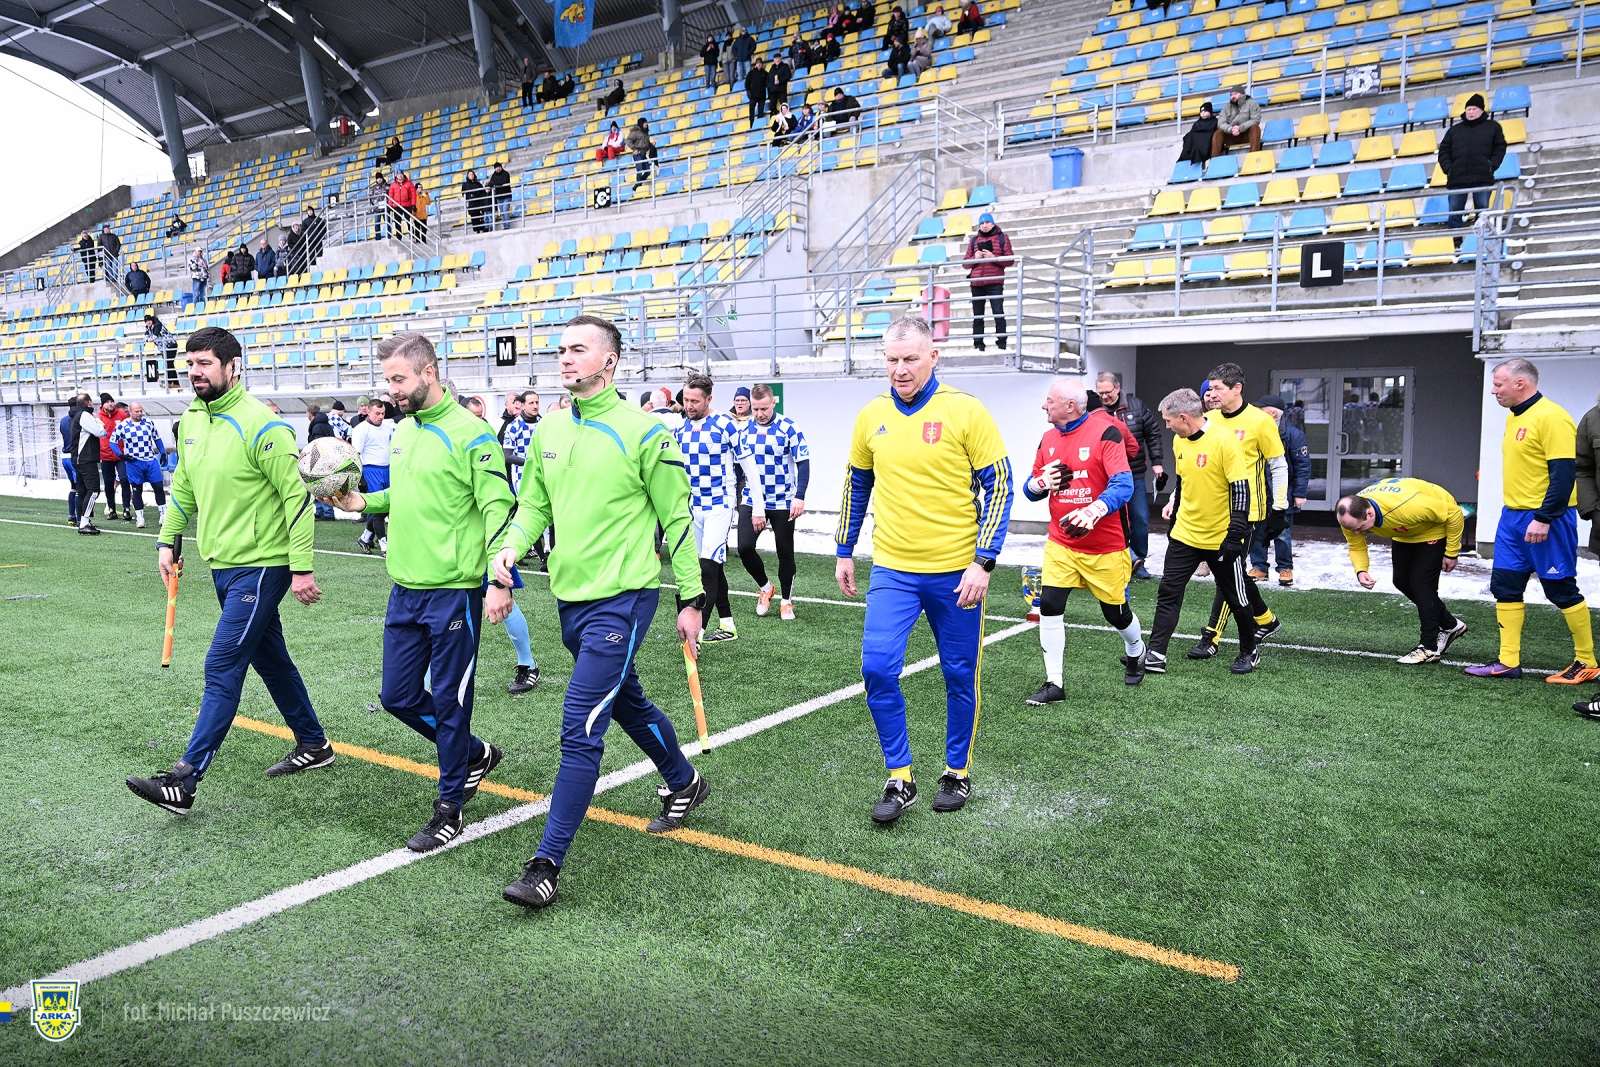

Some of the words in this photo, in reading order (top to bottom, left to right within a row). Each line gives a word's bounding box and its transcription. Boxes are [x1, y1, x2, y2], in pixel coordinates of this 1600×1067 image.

[329, 195, 337, 207] B
[1311, 252, 1332, 279] L
[37, 278, 44, 290] A
[499, 342, 513, 361] M
[148, 364, 156, 379] N
[1059, 487, 1091, 497] Energa
